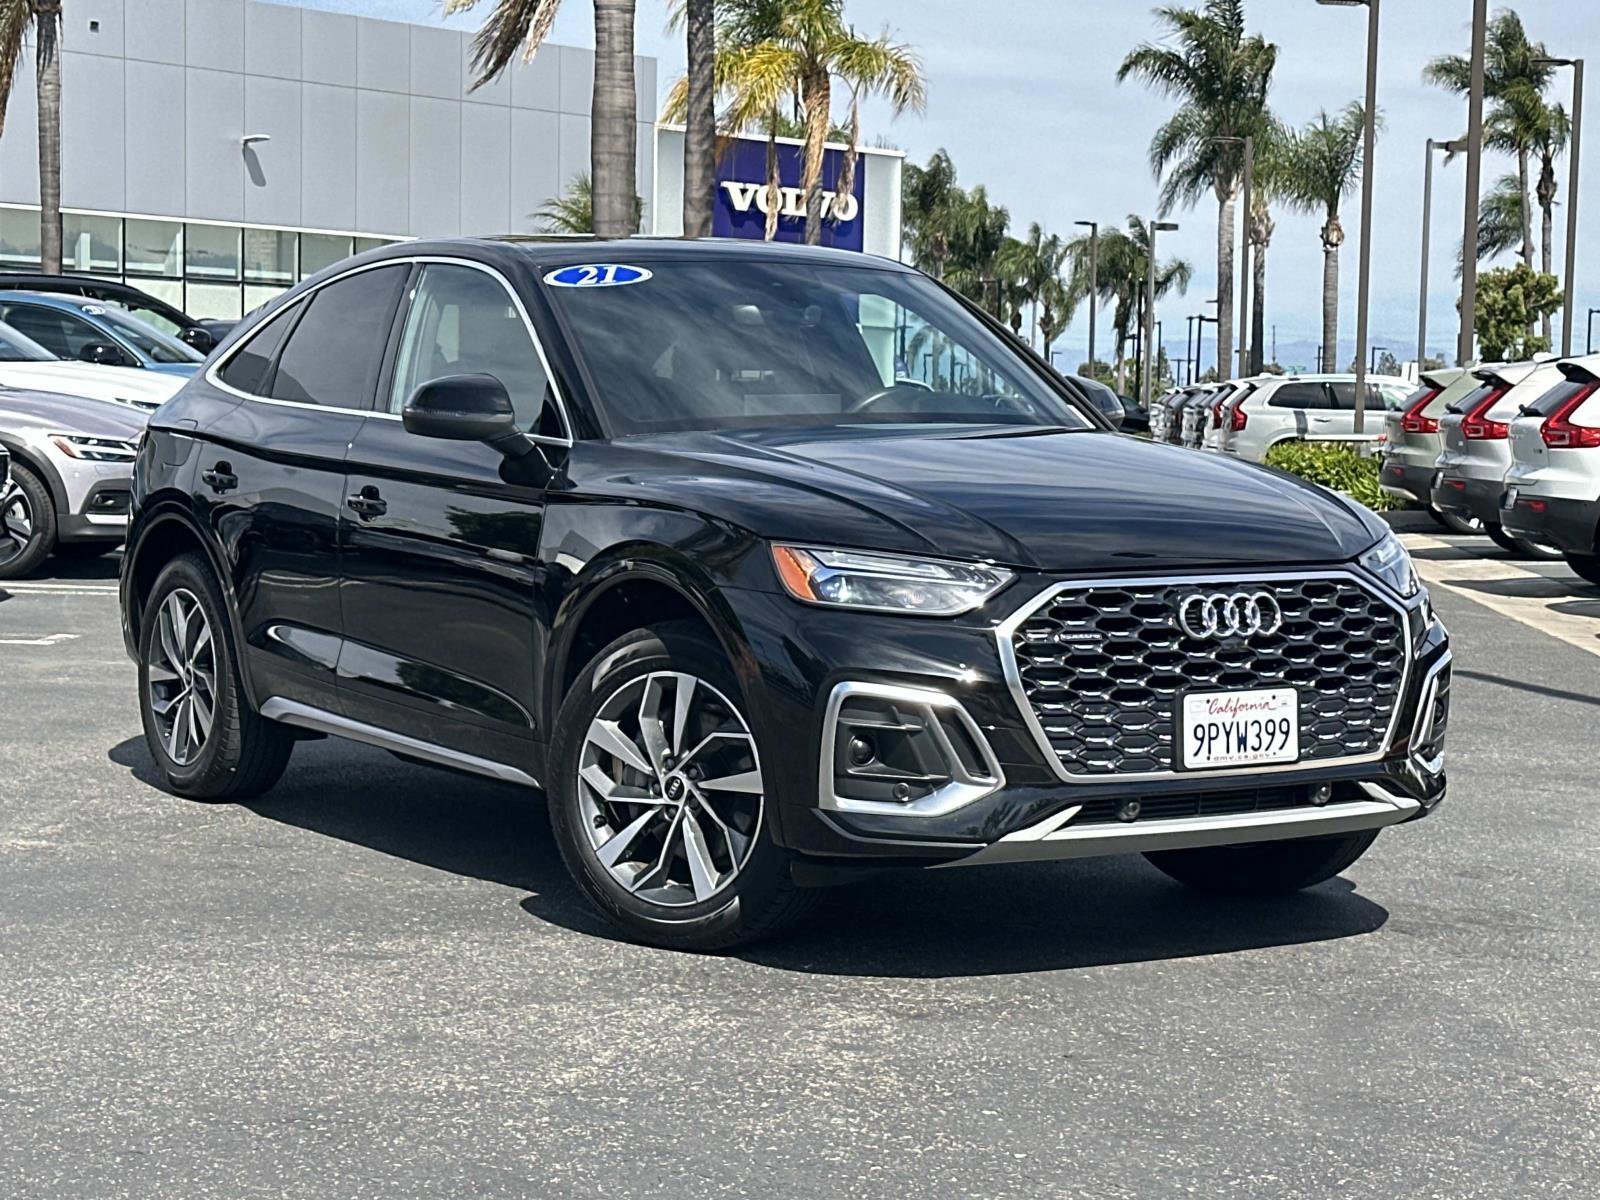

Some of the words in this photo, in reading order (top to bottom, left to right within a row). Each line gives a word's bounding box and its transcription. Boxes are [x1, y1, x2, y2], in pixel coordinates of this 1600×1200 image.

[576, 265, 618, 286] 21
[1208, 697, 1278, 718] California
[1193, 717, 1291, 757] 9PYW399
